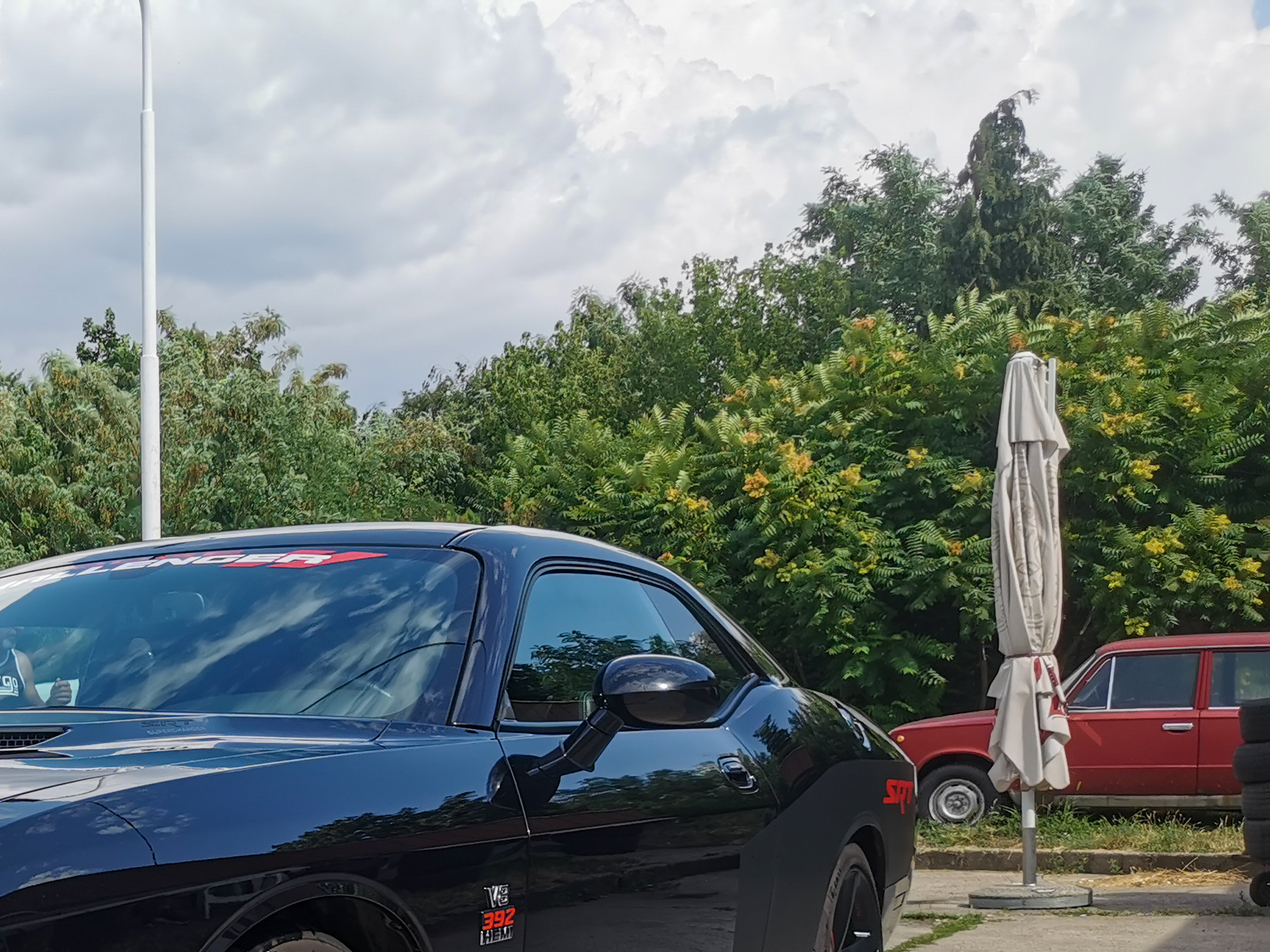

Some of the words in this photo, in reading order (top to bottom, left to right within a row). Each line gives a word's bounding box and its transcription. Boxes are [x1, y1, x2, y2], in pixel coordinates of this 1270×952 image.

[883, 779, 914, 814] SRT
[482, 908, 516, 930] 392
[480, 925, 513, 946] HEMI
